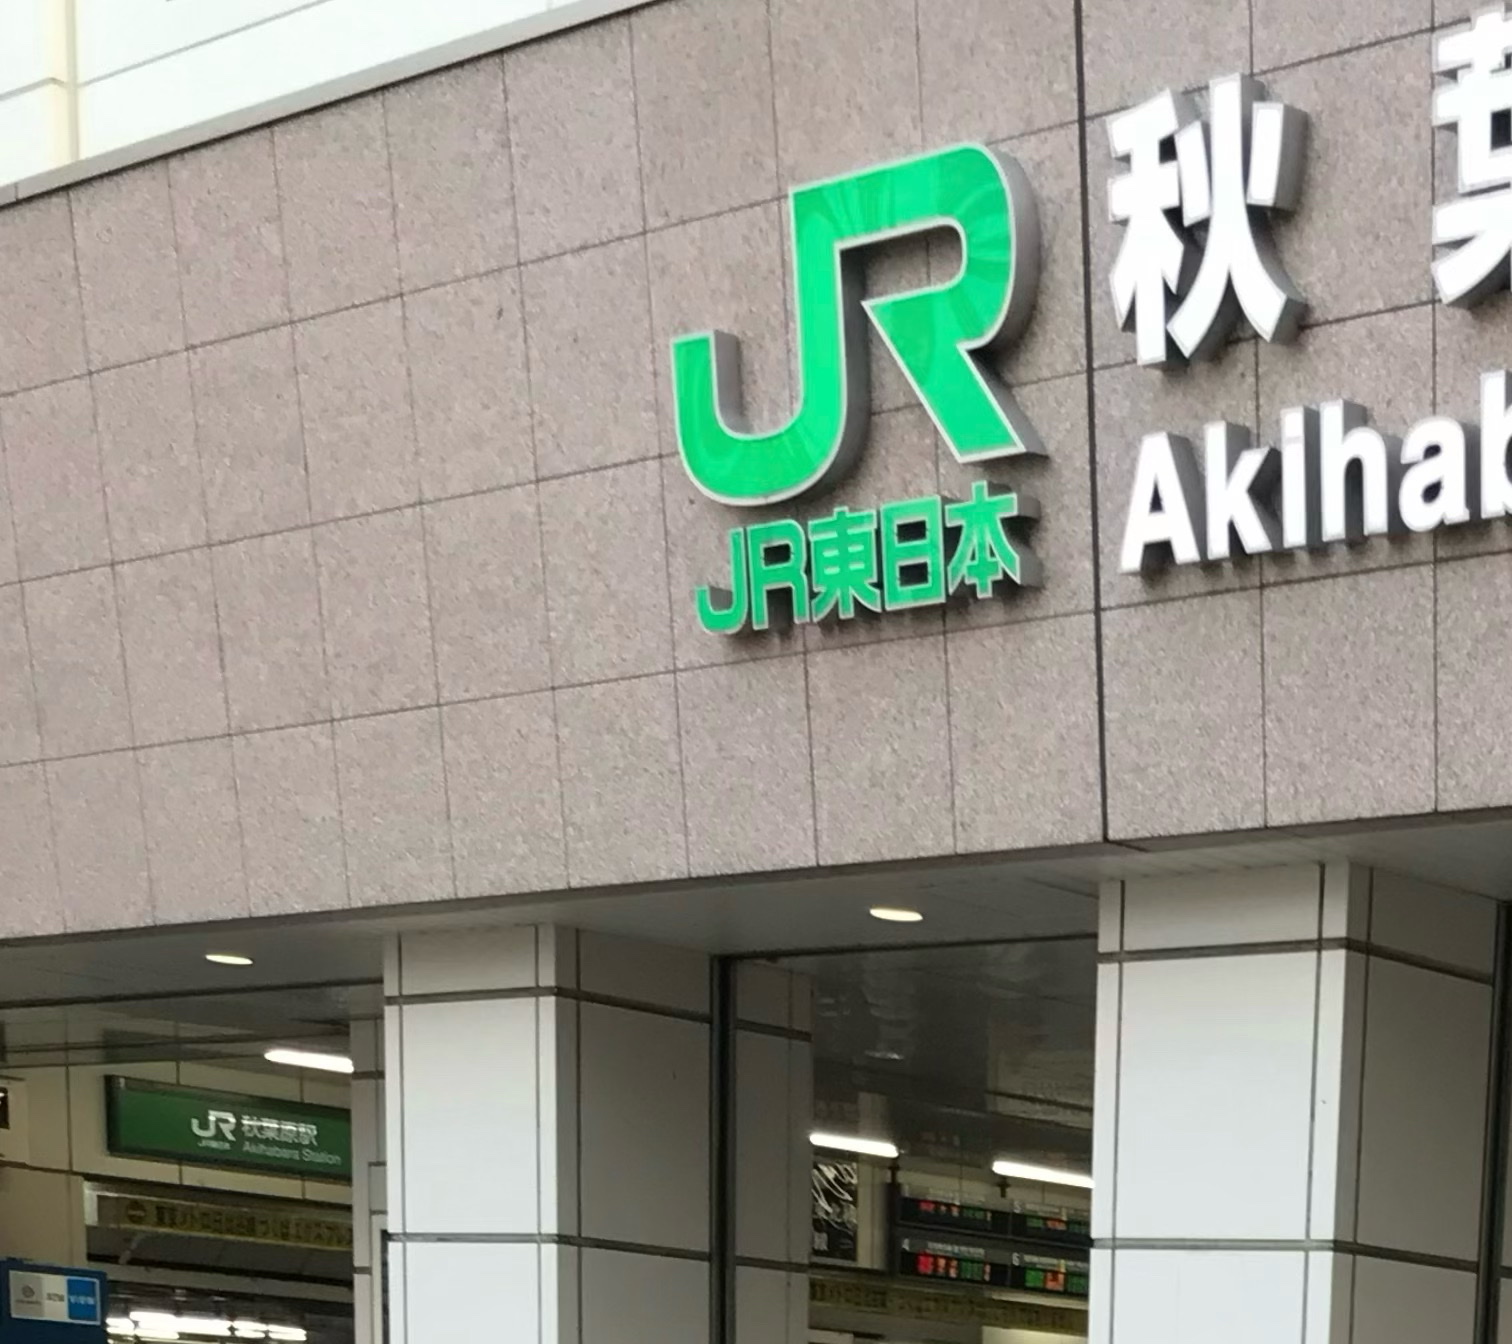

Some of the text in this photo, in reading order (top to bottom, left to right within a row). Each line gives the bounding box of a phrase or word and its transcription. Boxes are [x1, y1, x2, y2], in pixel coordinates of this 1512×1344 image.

[671, 141, 1027, 507] JR
[696, 481, 1023, 635] JR東日本
[191, 1110, 237, 1141] JR
